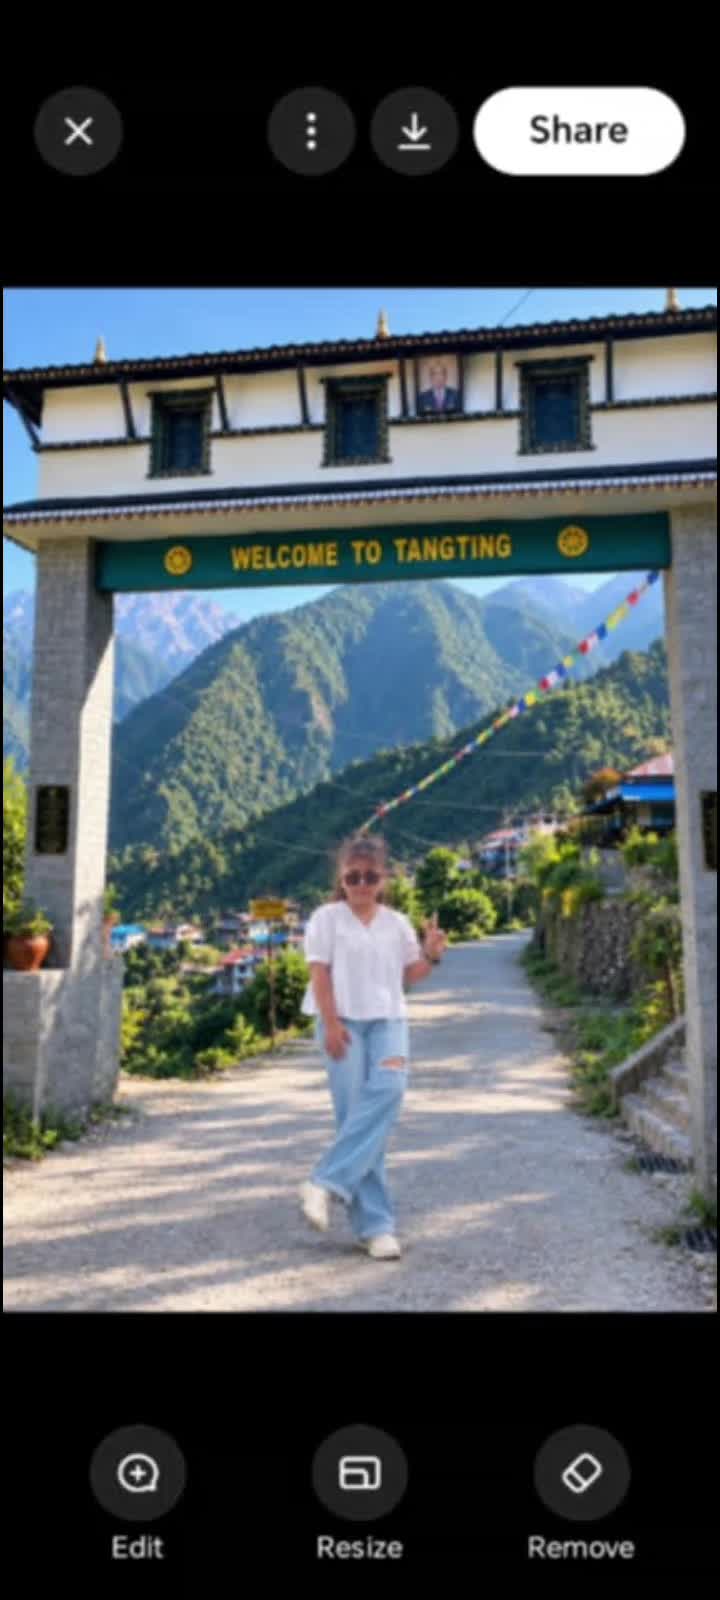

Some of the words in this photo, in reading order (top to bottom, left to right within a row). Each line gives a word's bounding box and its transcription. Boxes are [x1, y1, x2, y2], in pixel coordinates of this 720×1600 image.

[231, 542, 339, 571] WELCOME
[352, 540, 382, 565] TO
[393, 533, 512, 562] TANGTING
